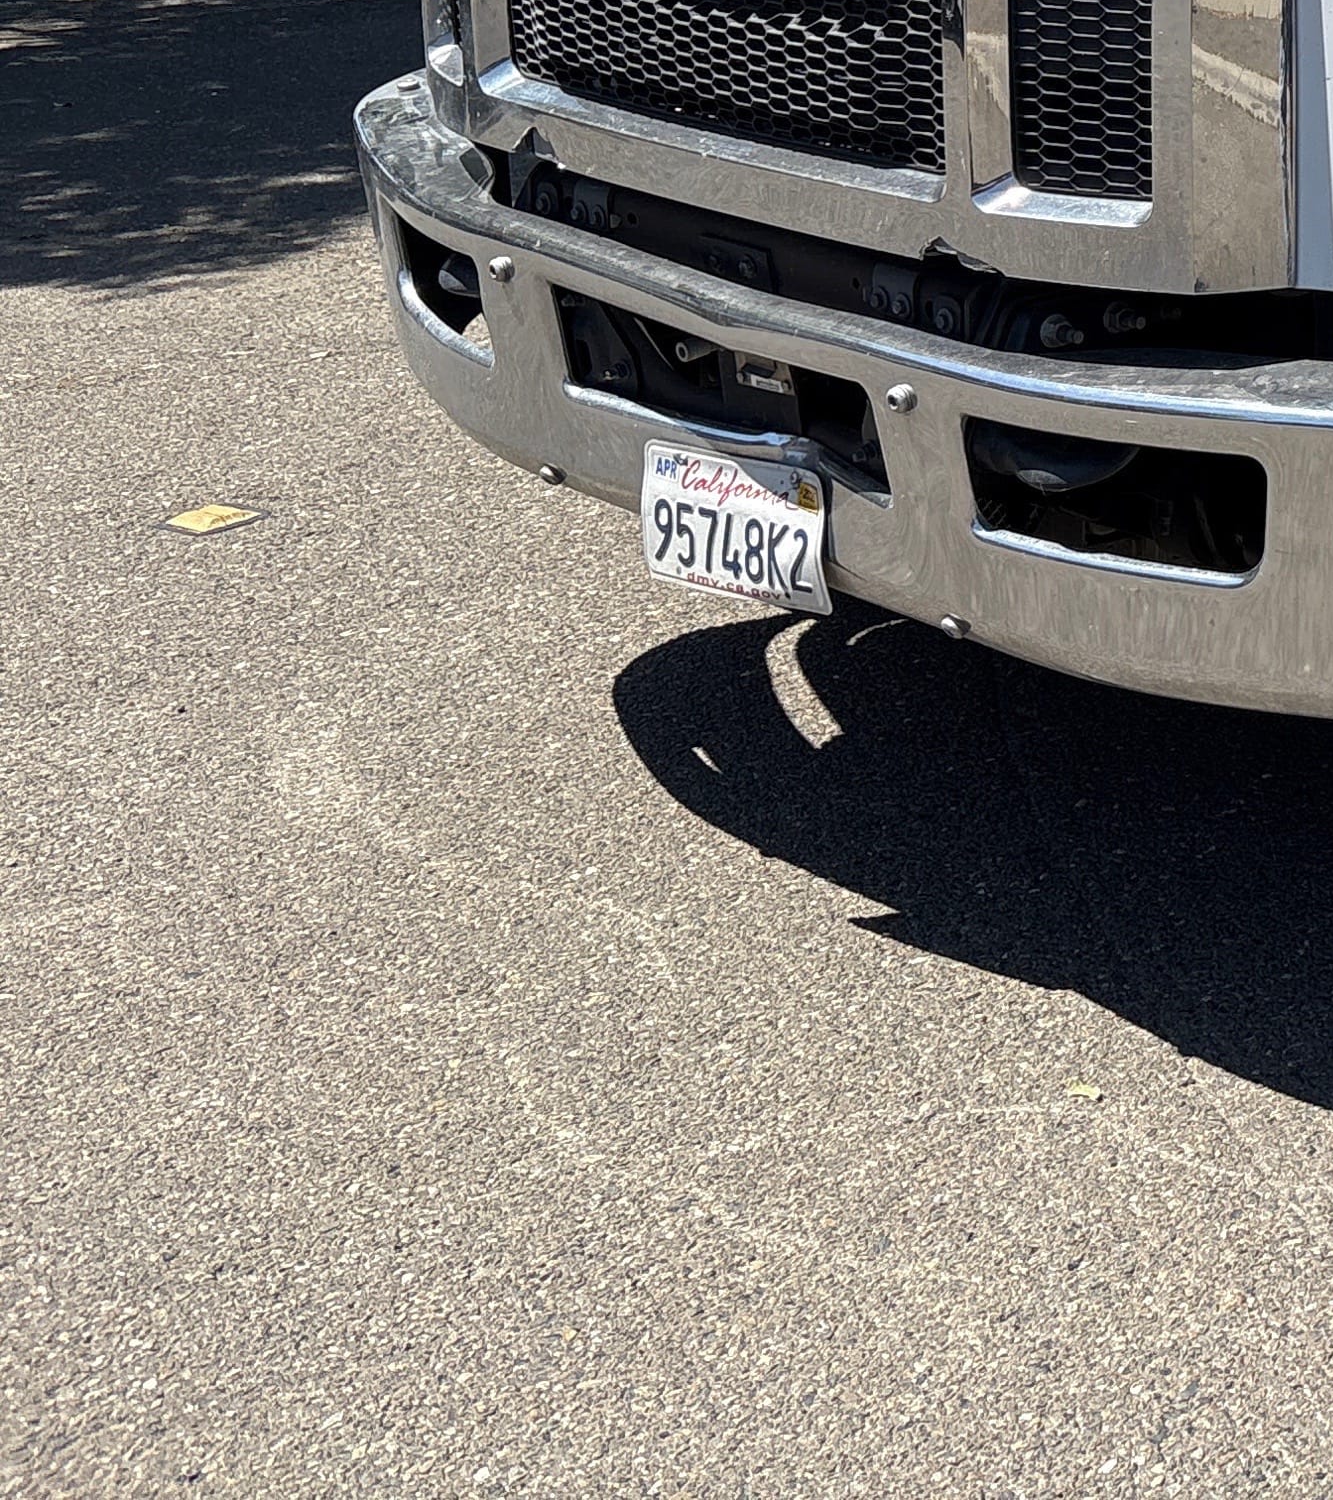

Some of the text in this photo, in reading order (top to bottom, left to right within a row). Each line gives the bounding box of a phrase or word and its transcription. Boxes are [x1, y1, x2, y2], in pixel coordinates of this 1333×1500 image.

[655, 456, 678, 480] APR
[680, 459, 799, 511] California
[653, 498, 813, 599] 95748K2
[686, 571, 783, 601] dmv.ca.gov
